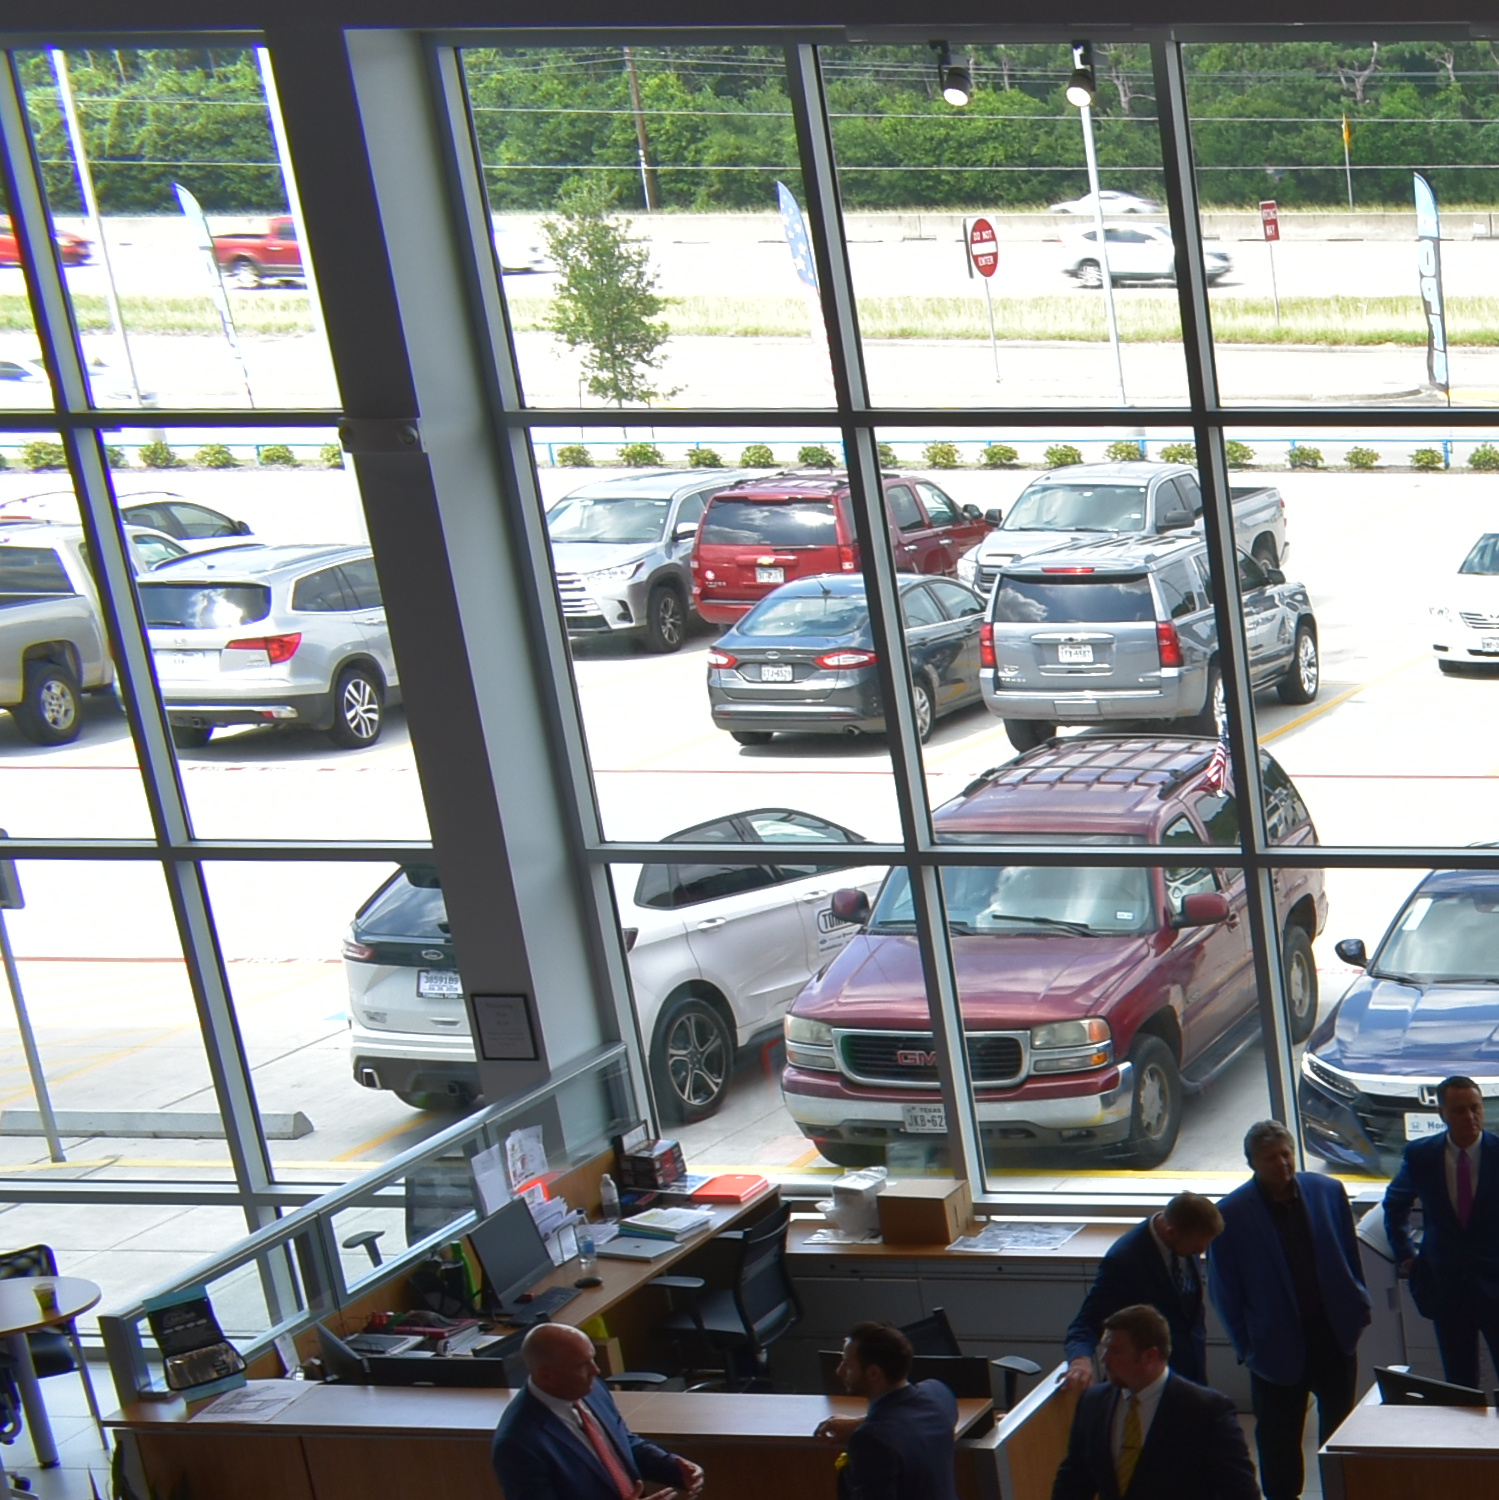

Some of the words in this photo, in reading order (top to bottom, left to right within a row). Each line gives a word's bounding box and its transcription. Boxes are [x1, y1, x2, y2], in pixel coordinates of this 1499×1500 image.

[972, 231, 981, 241] DO
[982, 229, 993, 240] NOT
[1266, 225, 1276, 236] WAY
[978, 256, 994, 267] ENTER
[898, 1051, 937, 1066] GM
[1427, 1121, 1448, 1130] Hon
